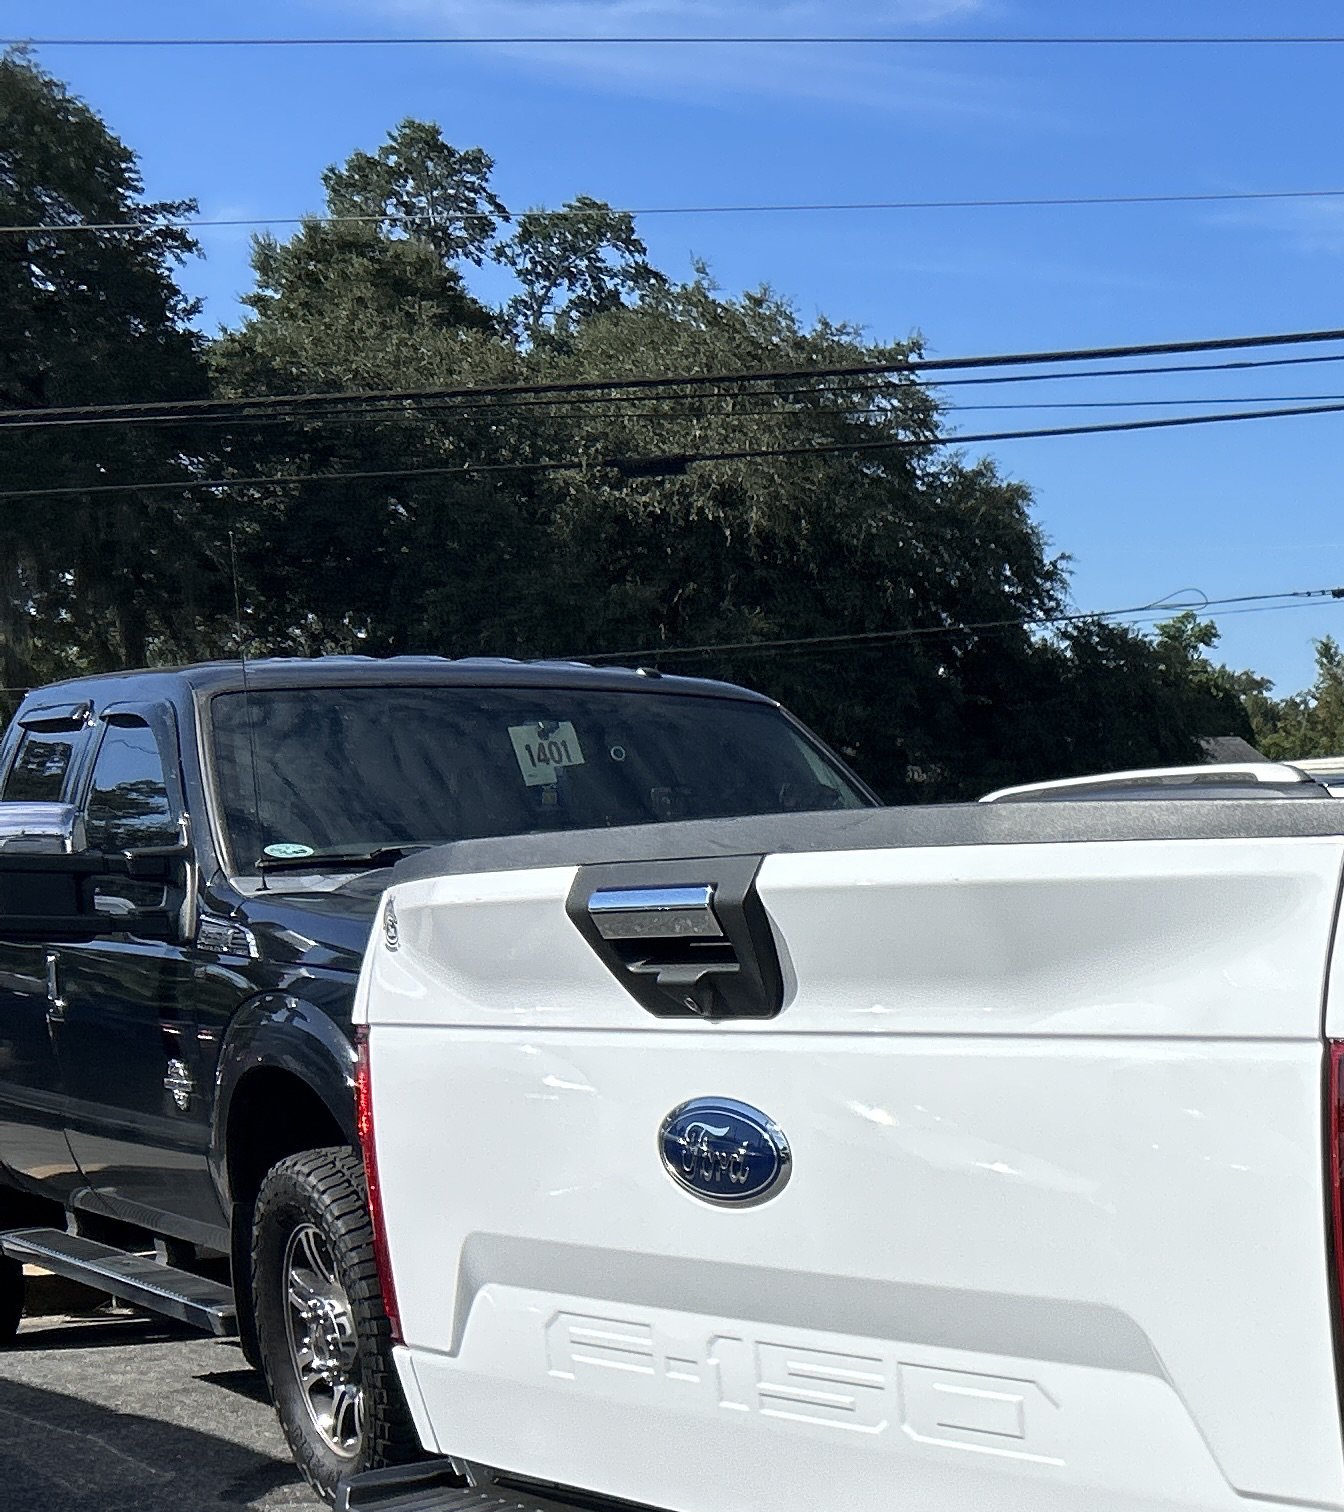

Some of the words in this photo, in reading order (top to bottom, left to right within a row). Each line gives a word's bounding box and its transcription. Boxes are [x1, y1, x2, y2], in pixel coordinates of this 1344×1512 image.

[525, 740, 573, 767] 1401
[680, 1122, 750, 1184] Ford
[545, 1311, 1067, 1466] F-150
